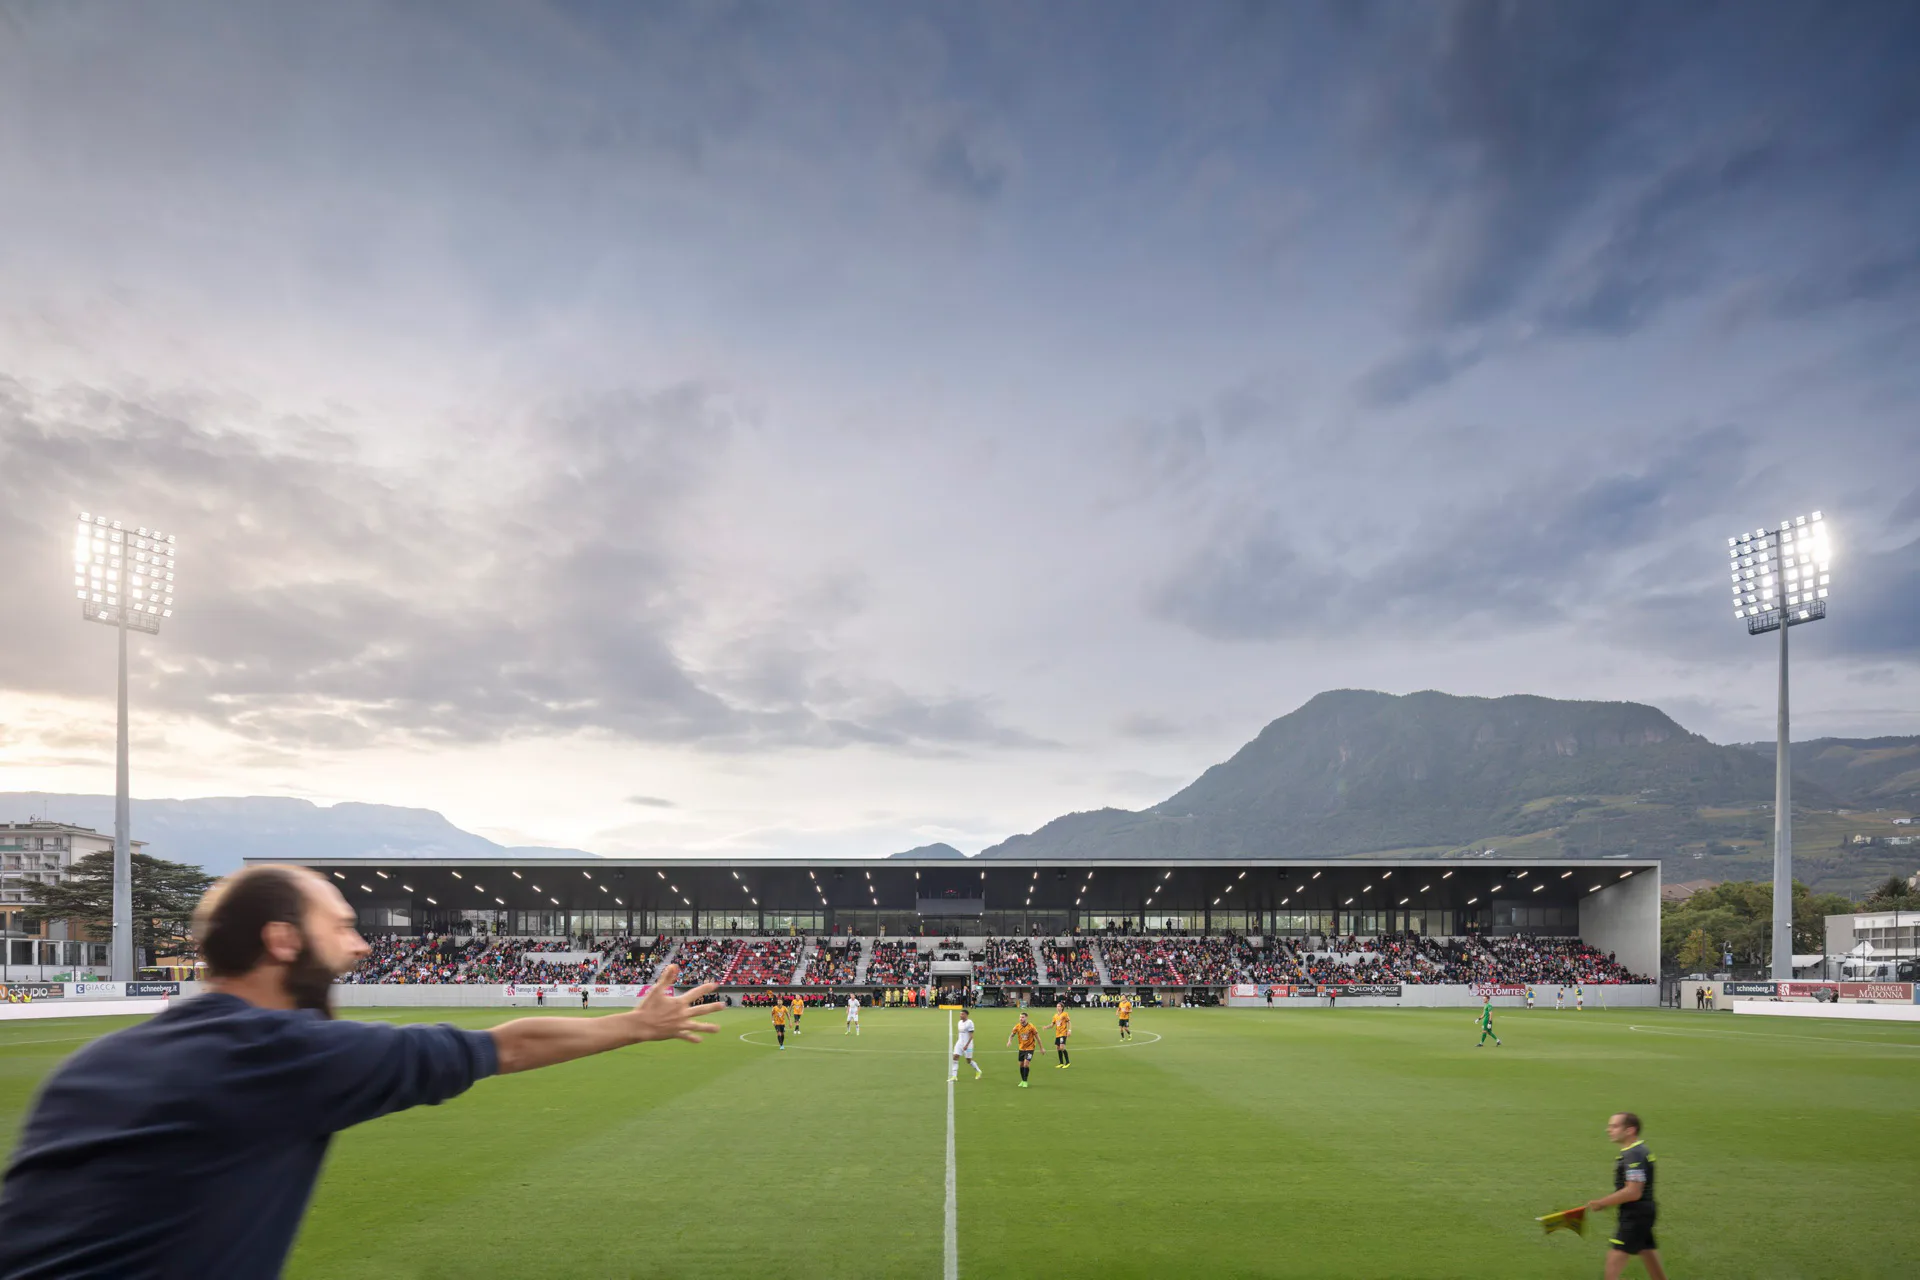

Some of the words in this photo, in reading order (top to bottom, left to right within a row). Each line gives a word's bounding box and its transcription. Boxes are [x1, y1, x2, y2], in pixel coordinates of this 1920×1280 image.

[140, 985, 177, 994] schneeberg.it
[1480, 988, 1526, 996] DOLOMITES
[1736, 985, 1775, 993] schneeberg.it
[1867, 984, 1903, 992] FARMACIA
[1859, 989, 1904, 999] MADONNA
